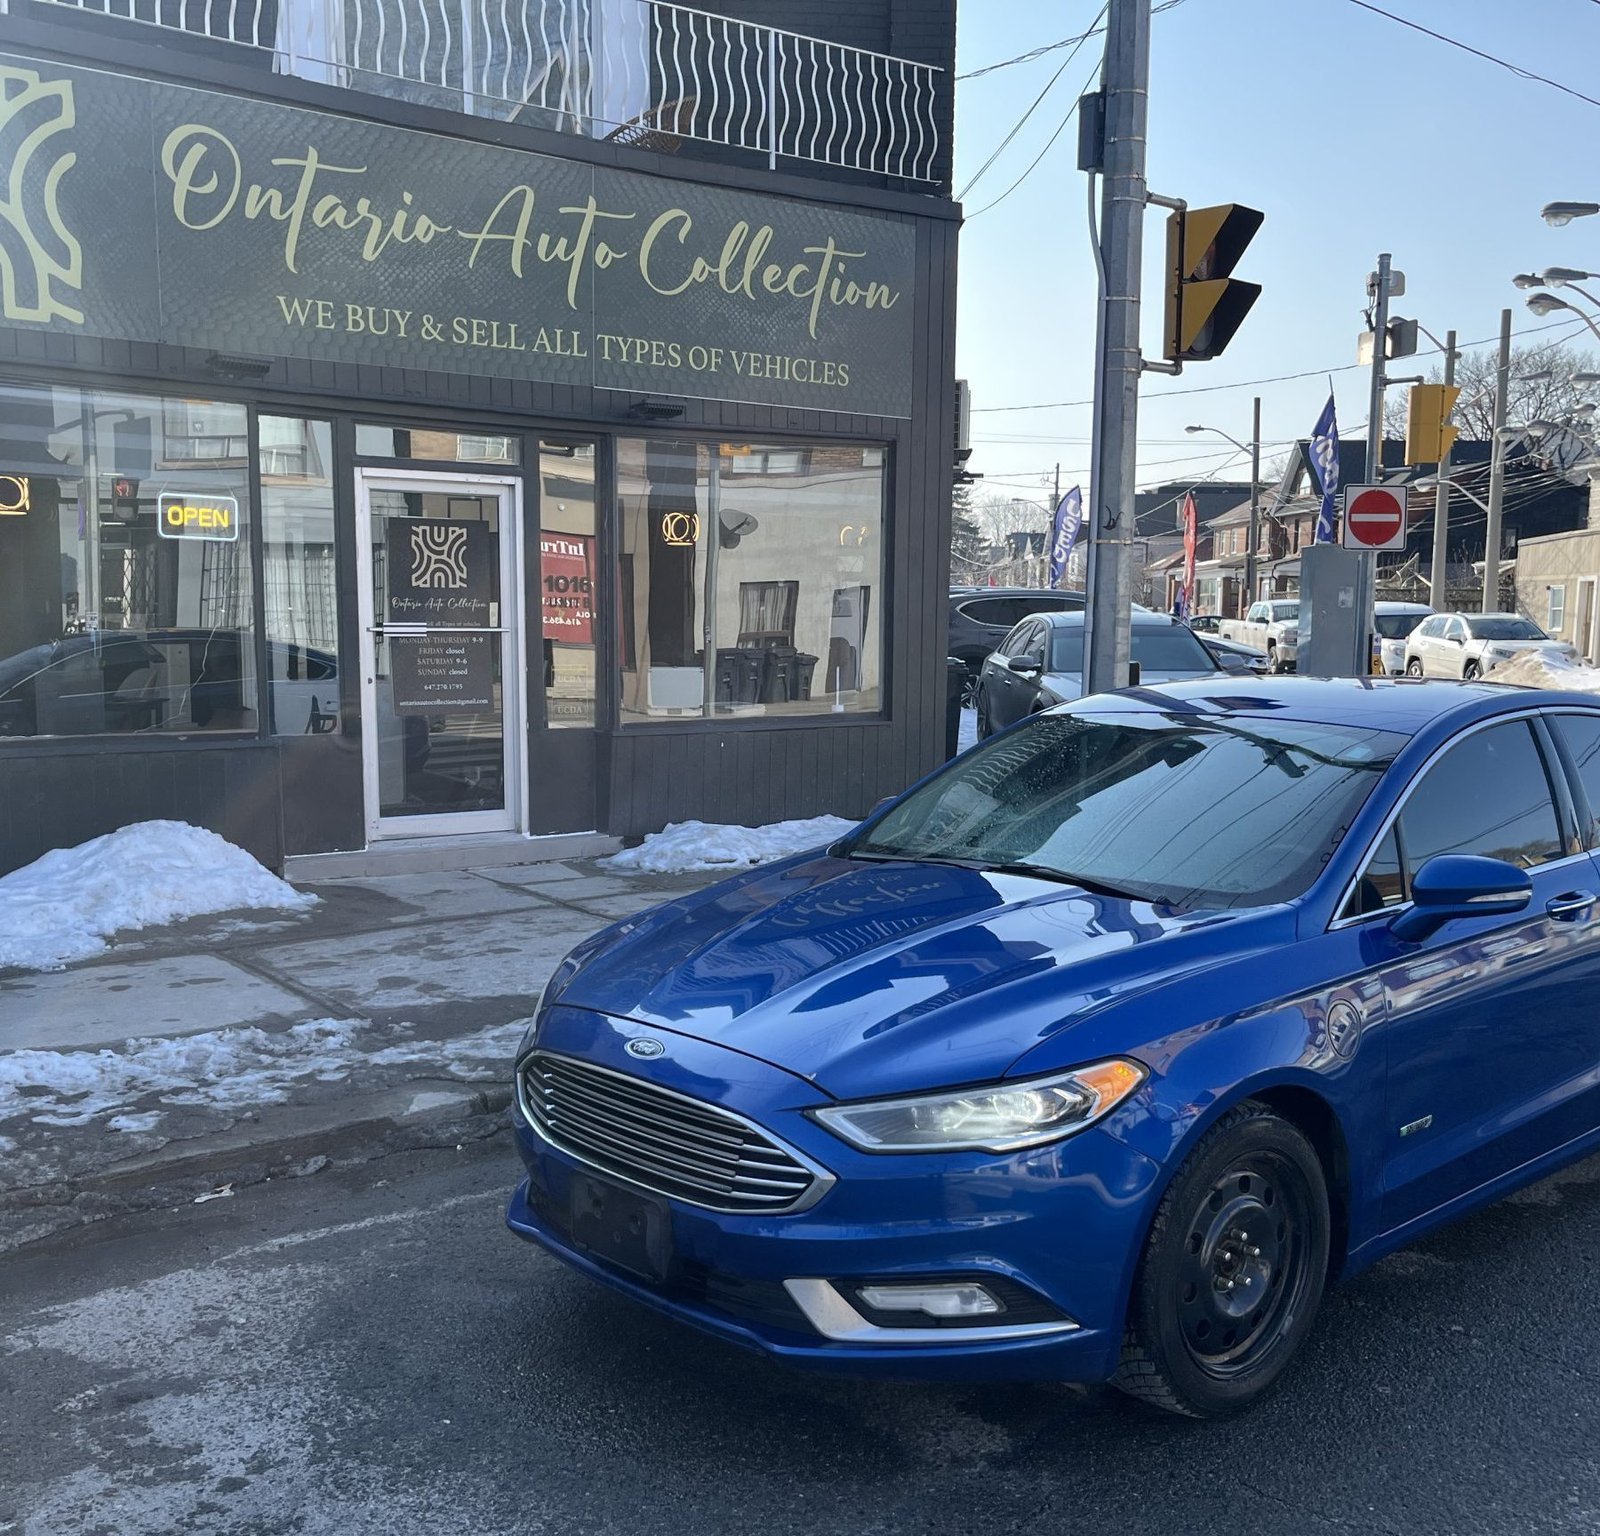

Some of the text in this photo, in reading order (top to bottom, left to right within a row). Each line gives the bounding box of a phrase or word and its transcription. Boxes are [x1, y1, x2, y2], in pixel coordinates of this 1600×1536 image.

[161, 123, 900, 340] Ontario Auto Collection
[277, 295, 851, 387] WE BUY & SELL ALL TYPES OF VEHICLES
[166, 504, 230, 529] OPEN
[391, 597, 487, 612] Ontario Auto Collection
[419, 647, 444, 655] FRIDAY
